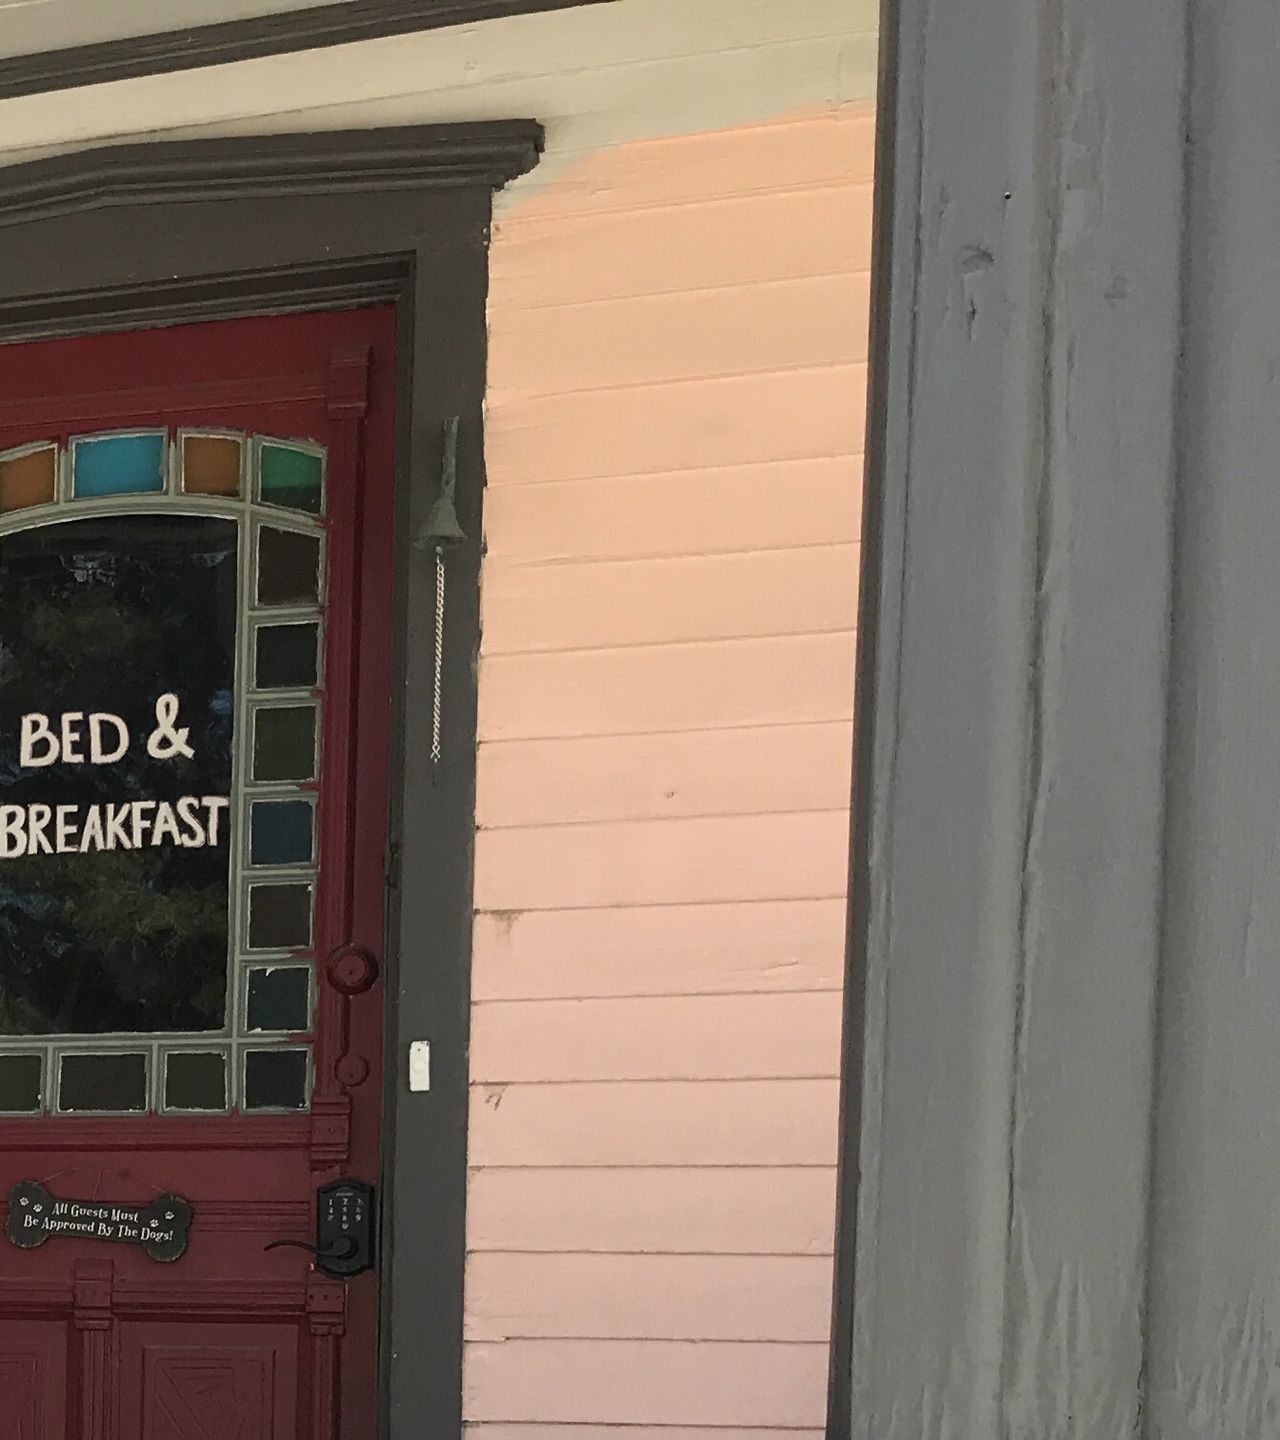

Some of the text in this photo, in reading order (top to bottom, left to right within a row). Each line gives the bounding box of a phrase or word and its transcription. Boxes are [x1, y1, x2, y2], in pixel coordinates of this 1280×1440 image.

[20, 692, 196, 768] BED &
[51, 1202, 139, 1222] All Guests Must
[23, 1214, 174, 1243] Be Approved By The Dogs!
